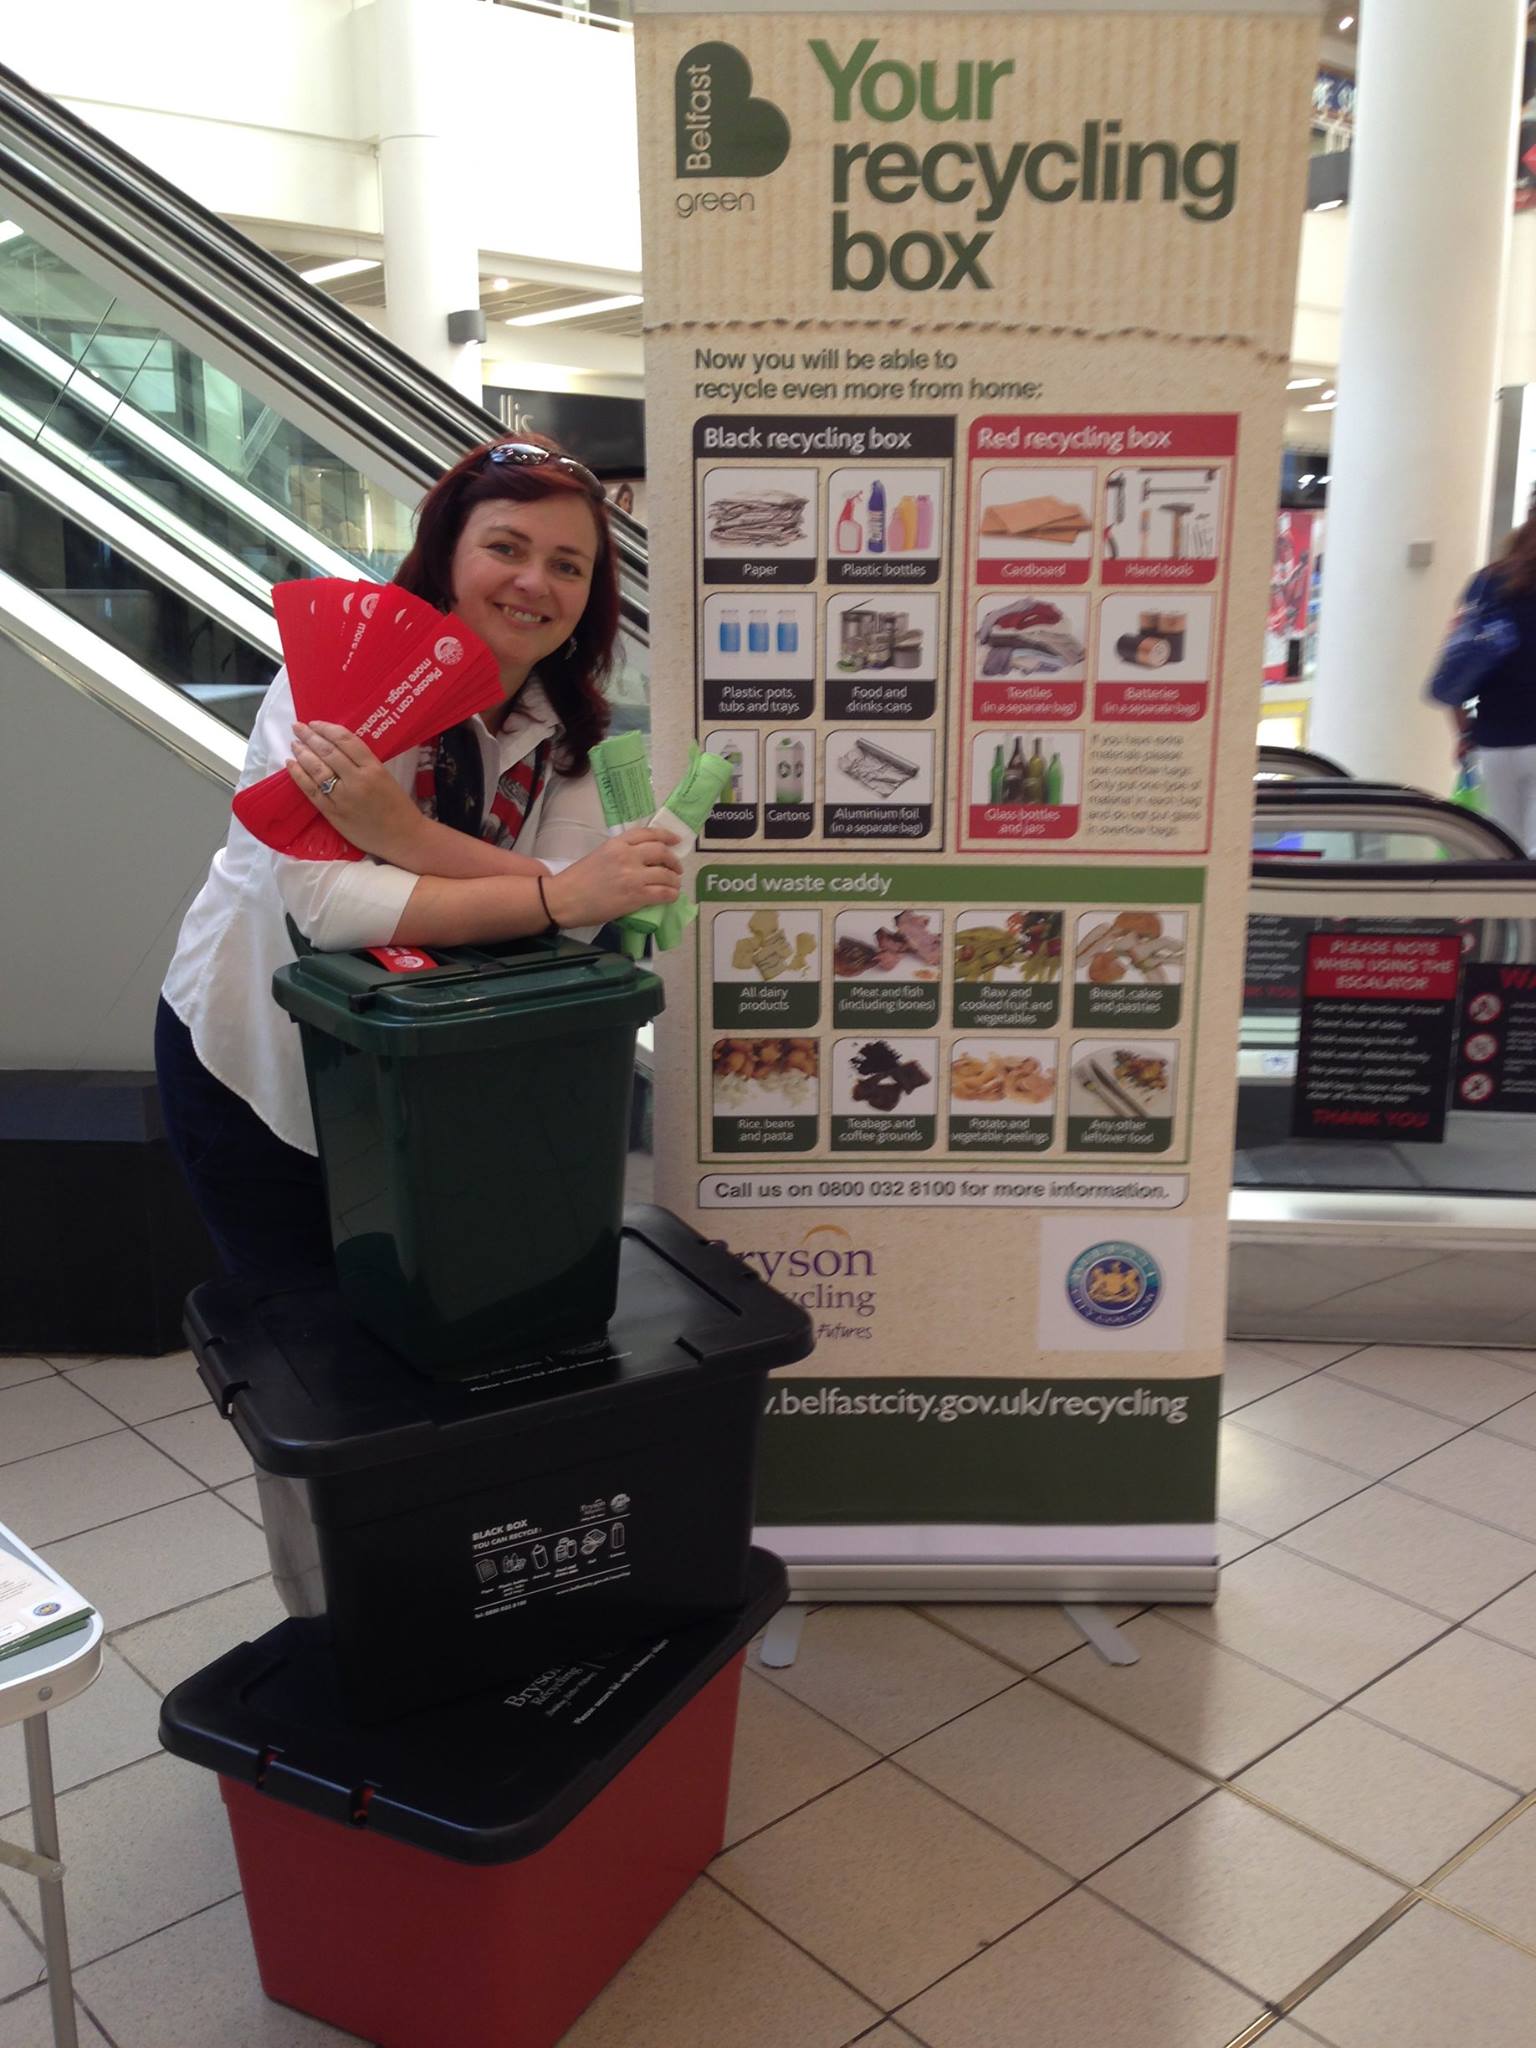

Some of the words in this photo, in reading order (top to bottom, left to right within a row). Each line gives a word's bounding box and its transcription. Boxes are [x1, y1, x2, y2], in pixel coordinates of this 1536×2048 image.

[808, 38, 1015, 123] Your
[685, 63, 712, 171] Belfast
[832, 119, 1240, 222] recycling
[675, 189, 754, 219] green
[831, 210, 996, 292] box
[695, 349, 745, 369] Now
[752, 352, 795, 374] you
[803, 349, 839, 369] will
[846, 349, 875, 369] be
[879, 349, 929, 370] able
[935, 350, 957, 370] to
[695, 379, 777, 403] recycle
[783, 383, 837, 399] even
[844, 383, 904, 399] more
[910, 378, 963, 399] from
[704, 427, 762, 449] Black
[767, 427, 864, 454] recycling
[869, 427, 912, 449] box
[978, 426, 1020, 448] Red
[1025, 425, 1124, 454] recycling
[1127, 426, 1172, 449] box
[743, 564, 778, 577] Paper
[842, 562, 882, 576] Plastic
[885, 562, 926, 576] bottles
[1002, 563, 1066, 577] Cardboard
[408, 657, 432, 683] more
[413, 667, 444, 697] Please
[722, 686, 763, 698] Plastic
[767, 688, 796, 700] pots,
[852, 686, 882, 698] Food
[884, 686, 907, 698] and
[1007, 686, 1054, 699] Textiles
[1124, 686, 1180, 699] Batteries
[396, 695, 414, 713] can
[719, 701, 745, 713] tubs
[747, 701, 768, 713] and
[771, 702, 799, 715] trays
[847, 701, 883, 713] drinks
[884, 703, 912, 713] cans
[372, 716, 397, 739] have
[709, 810, 754, 821] Aerosols
[767, 809, 811, 821] Cartons
[834, 807, 898, 820] Aluminium
[901, 807, 919, 820] foil
[984, 808, 1017, 821] Glass
[1018, 808, 1061, 821] bottles
[831, 822, 845, 834] (in
[846, 824, 854, 833] a
[856, 823, 898, 835] separate
[900, 822, 923, 835] bag)
[998, 822, 1022, 834] and
[1022, 823, 1046, 836] jars
[706, 874, 757, 892] Food
[762, 877, 825, 892] waste
[830, 873, 892, 895] caddy
[1335, 975, 1430, 990] ESCALATOR
[740, 987, 758, 997] All
[760, 987, 789, 1000] dairy
[851, 987, 879, 997] Meat
[881, 987, 900, 997] and
[903, 986, 924, 997] fish
[981, 987, 1007, 998] Raw
[1009, 987, 1032, 998] and
[1128, 989, 1163, 1000] cakes
[739, 1000, 790, 1012] products
[839, 999, 896, 1012] (including
[898, 999, 936, 1011] bones)
[960, 1000, 1003, 1011] cooked
[1005, 1000, 1029, 1011] fruit
[1030, 1000, 1053, 1011] and
[1090, 1001, 1116, 1012] and
[1116, 1002, 1161, 1014] pastries
[974, 1012, 1037, 1025] vegetables
[765, 1119, 795, 1129] beans
[848, 1118, 892, 1131] Teabags
[894, 1119, 916, 1129] and
[969, 1118, 1006, 1130] Potato
[1008, 1119, 1030, 1129] and
[1386, 1111, 1430, 1128] YOU
[739, 1131, 761, 1142] and
[763, 1132, 794, 1143] pasta
[840, 1131, 874, 1142] coffee
[876, 1131, 922, 1144] grounds
[952, 1131, 1005, 1143] vegetable
[1006, 1131, 1049, 1144] peelings
[715, 1181, 752, 1198] Call
[759, 1184, 783, 1197] us
[788, 1184, 813, 1197] on
[818, 1181, 864, 1197] 0800
[870, 1181, 904, 1197] 032
[910, 1180, 955, 1196] 8100
[960, 1181, 990, 1197] for
[993, 1183, 1045, 1197] more
[1050, 1181, 1170, 1199] information.
[472, 1526, 504, 1542] BLACK
[507, 1519, 528, 1533] BOX
[473, 1540, 489, 1551] YOU
[491, 1536, 508, 1547] CAN
